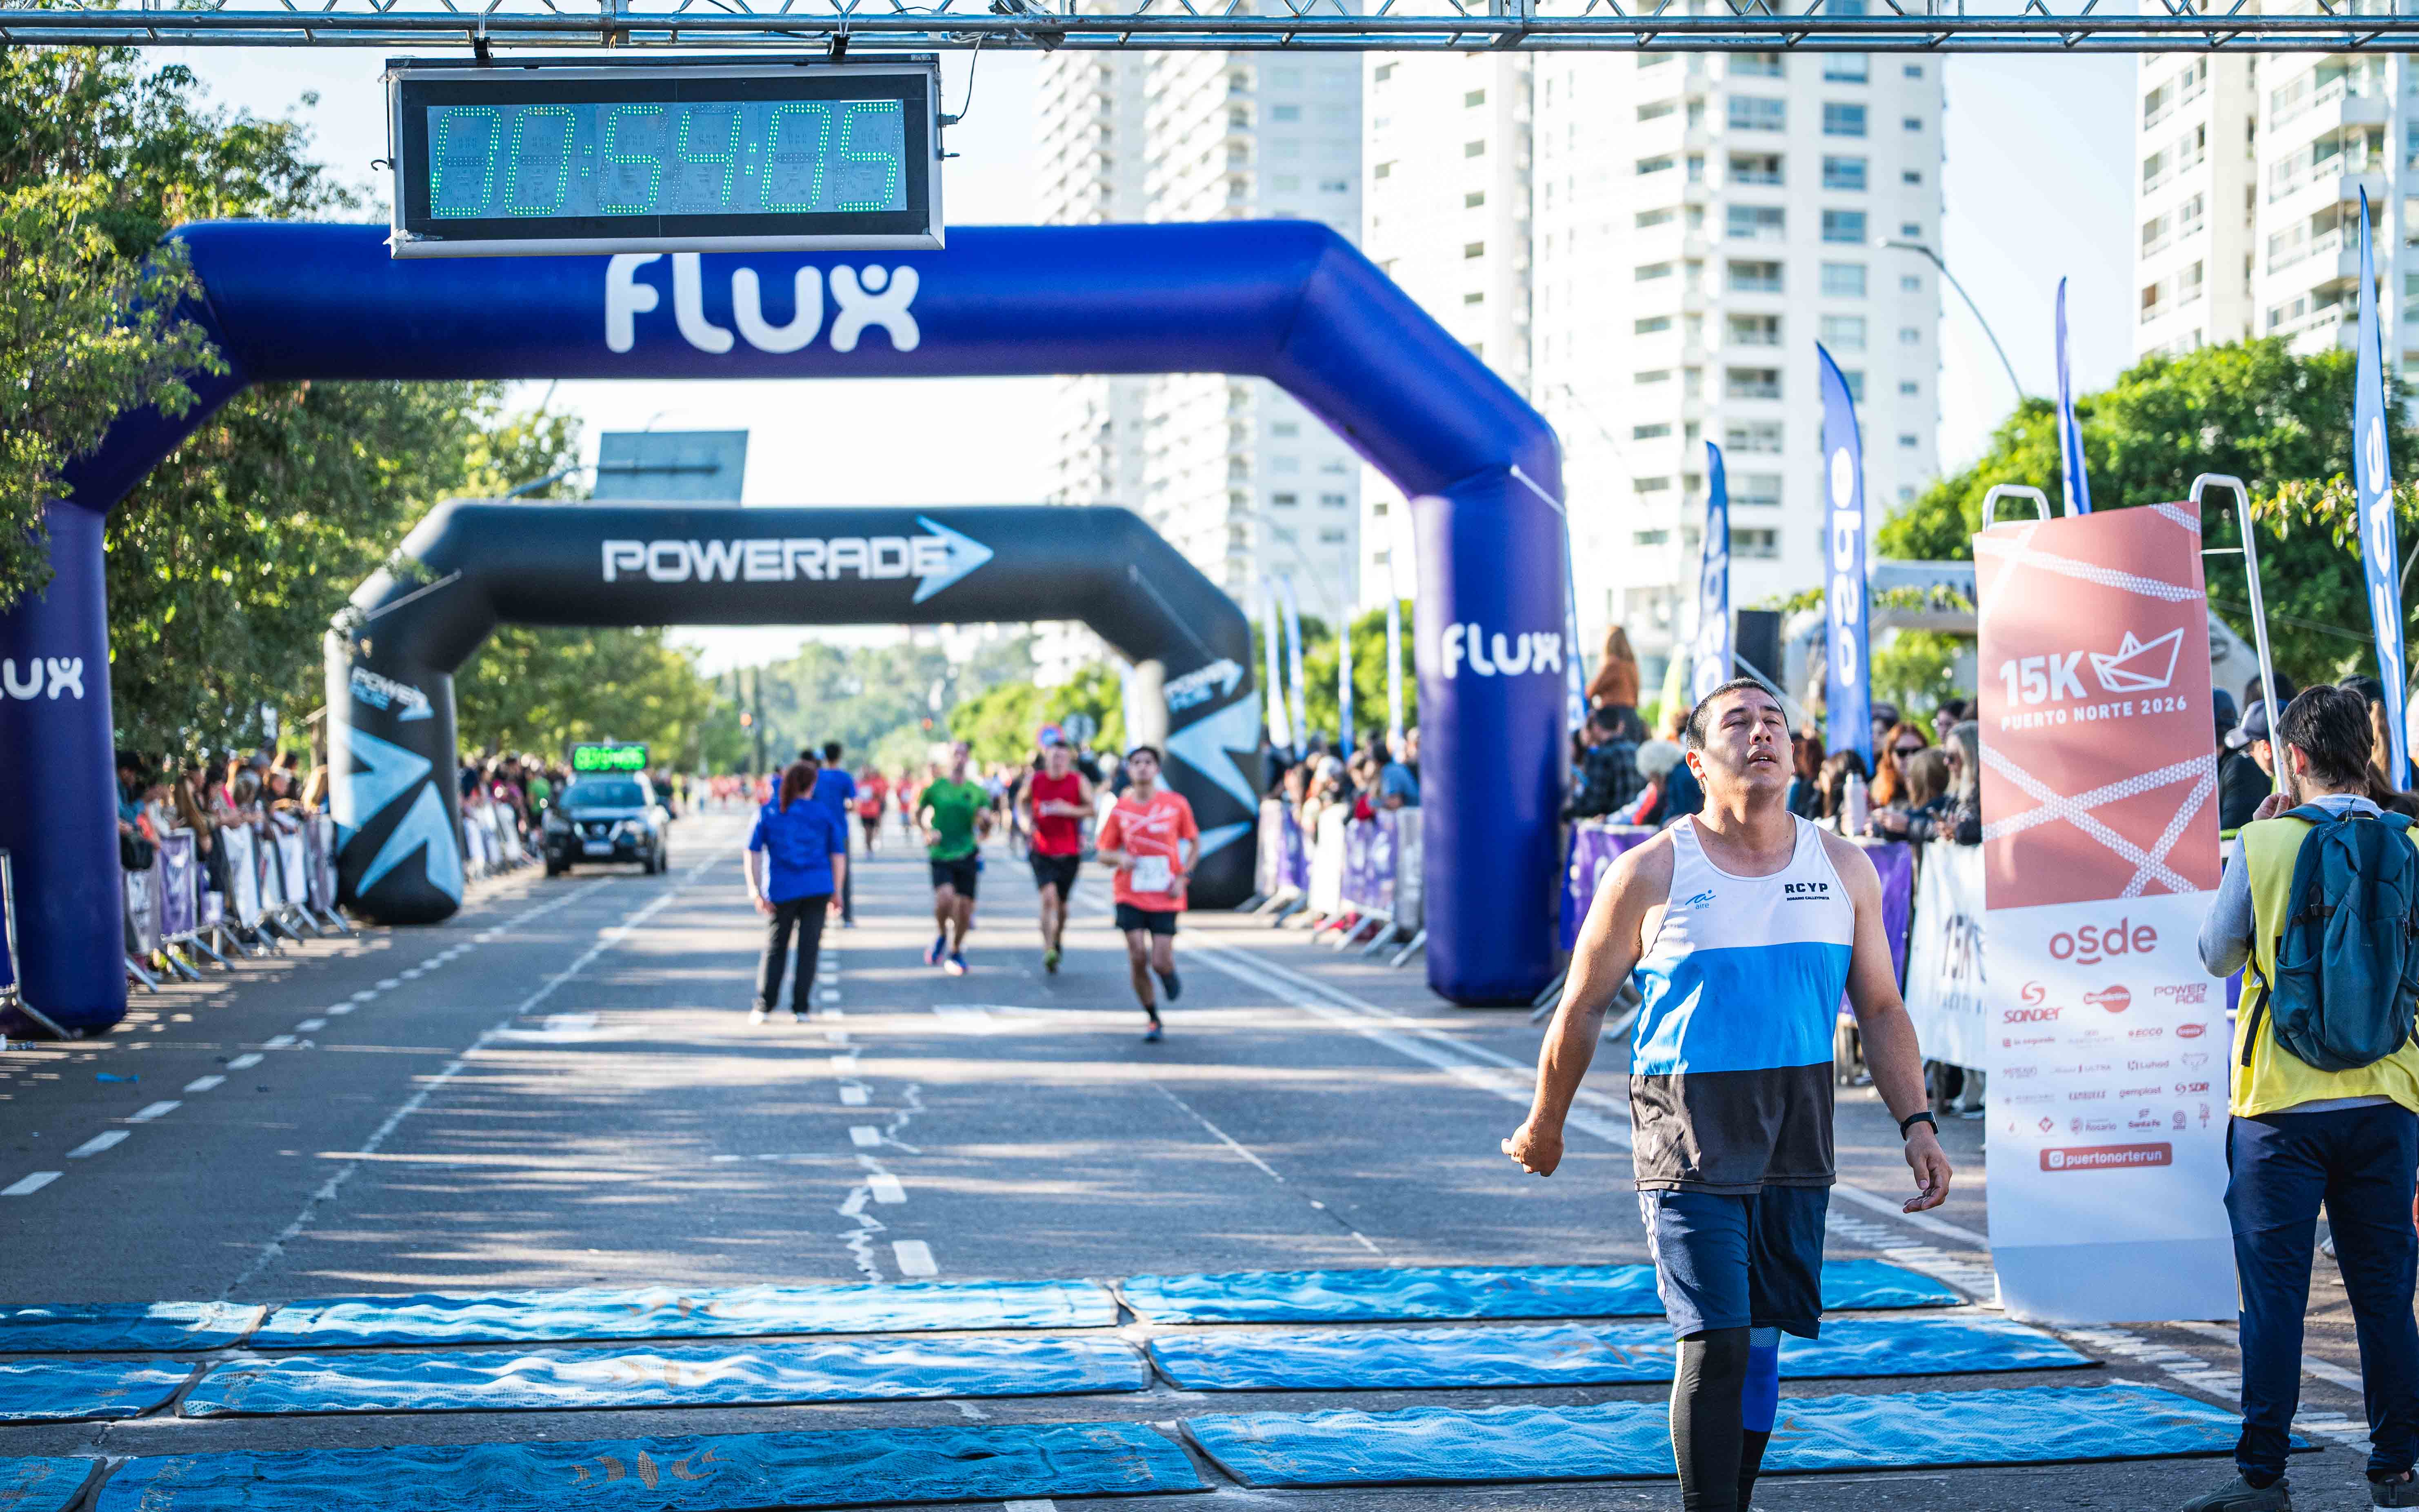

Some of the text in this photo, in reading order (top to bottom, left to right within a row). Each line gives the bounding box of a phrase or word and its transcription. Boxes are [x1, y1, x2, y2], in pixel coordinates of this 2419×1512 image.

[430, 101, 898, 216] 00:54:05
[602, 536, 949, 582] POWERADE
[1999, 651, 2088, 706] 15K
[2001, 695, 2187, 732] PUERTO NORTE 2026
[1784, 883, 1828, 893] RCYP
[2049, 917, 2157, 965] osde
[2154, 982, 2207, 996] POWER
[2135, 1028, 2163, 1038] ECCO
[2085, 1122, 2117, 1132] Rosario
[2066, 1150, 2162, 1168] puertonorterun
